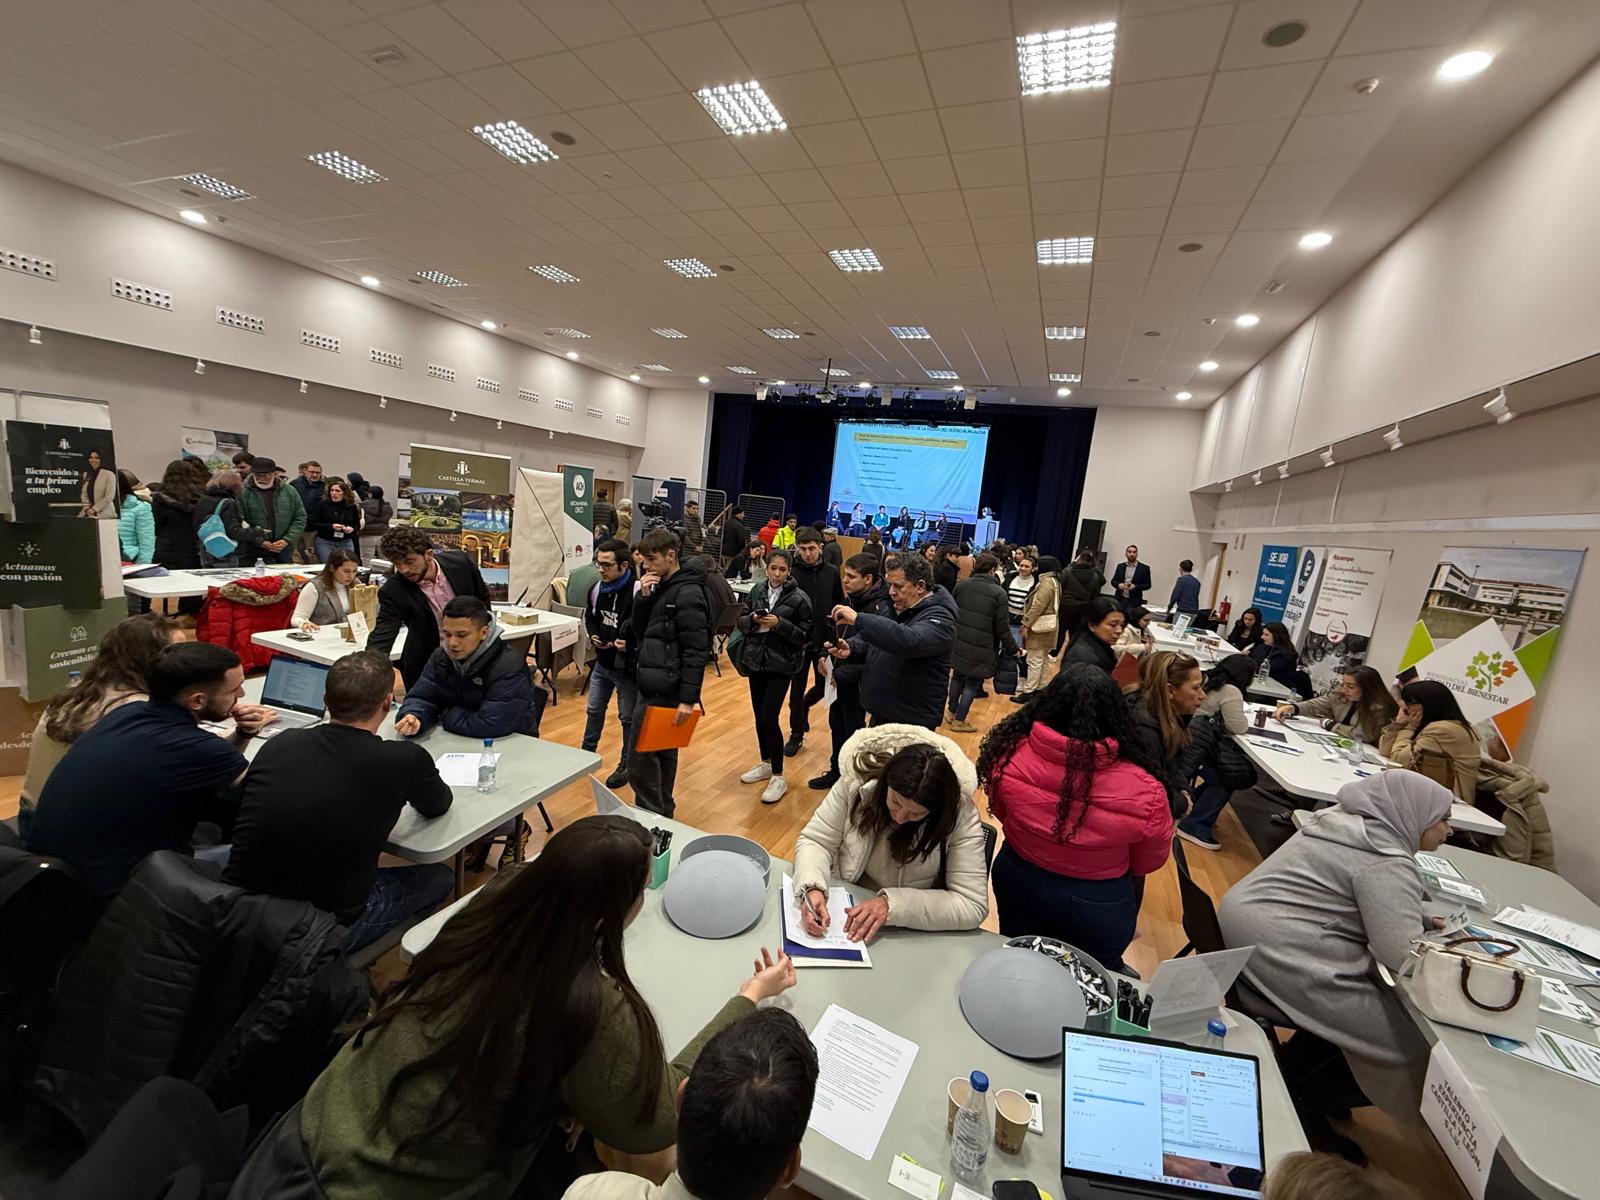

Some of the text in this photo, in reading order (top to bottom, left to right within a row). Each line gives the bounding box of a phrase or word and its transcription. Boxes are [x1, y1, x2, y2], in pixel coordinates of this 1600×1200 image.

[25, 467, 79, 476] Bienvenido/a
[34, 477, 45, 485] tu
[46, 476, 79, 486] primer
[465, 477, 486, 485] TERMAL
[27, 486, 61, 495] empleo
[1, 563, 56, 571] Actuamos
[24, 573, 62, 582] pasión
[1261, 574, 1285, 585] Personas
[49, 652, 99, 669] sostenibili
[1451, 682, 1467, 694] DEL
[1467, 687, 1509, 705] BIENESTAR
[1443, 1080, 1470, 1123] TALENTO
[1439, 1084, 1477, 1150] EXPERIENCIA
